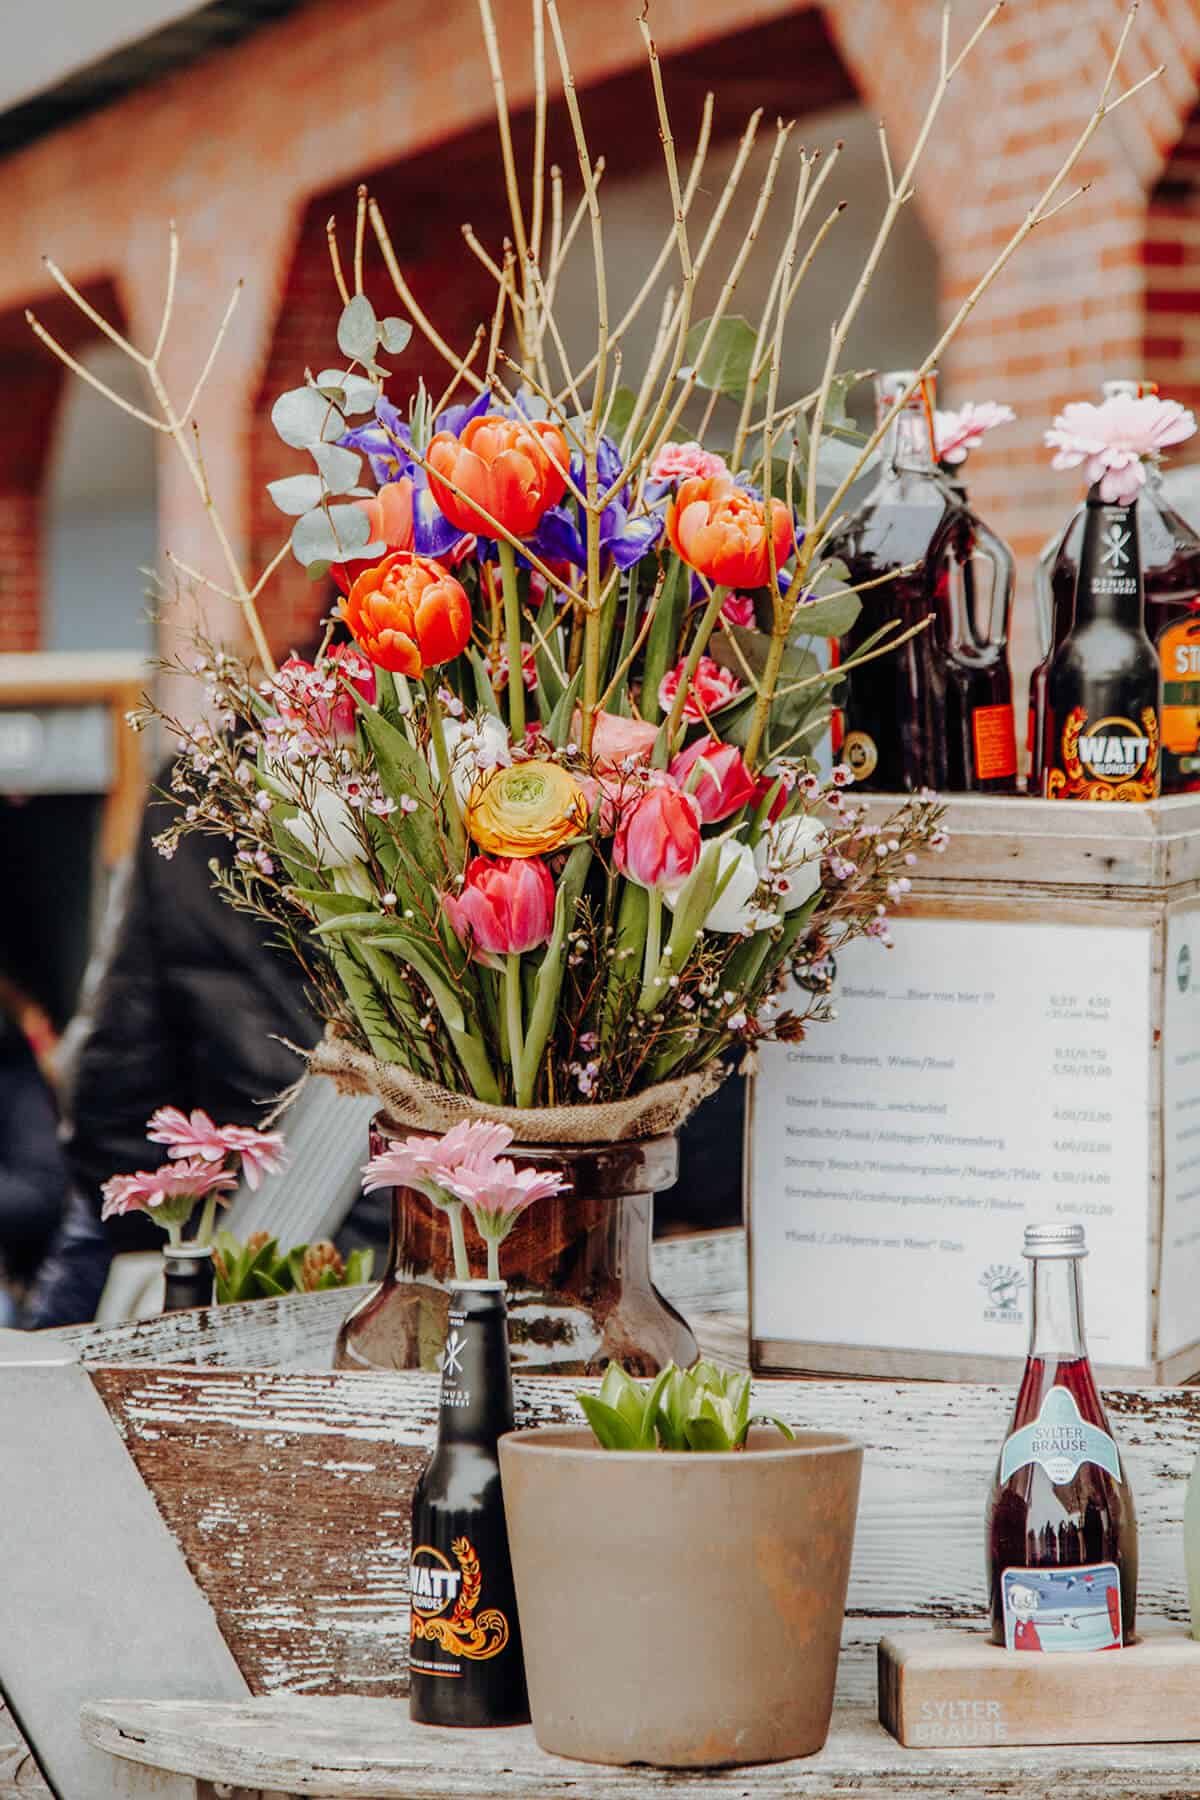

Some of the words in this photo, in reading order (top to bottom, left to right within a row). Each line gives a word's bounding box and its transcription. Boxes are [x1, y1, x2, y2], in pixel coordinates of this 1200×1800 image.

[1078, 735, 1150, 763] WATT
[1094, 762, 1137, 775] BLONDES
[1034, 1427, 1083, 1440] SYLTER
[1031, 1440, 1088, 1452] BRAUSE
[919, 1699, 1003, 1721] SYLTER
[913, 1722, 1007, 1743] BRAUSE
